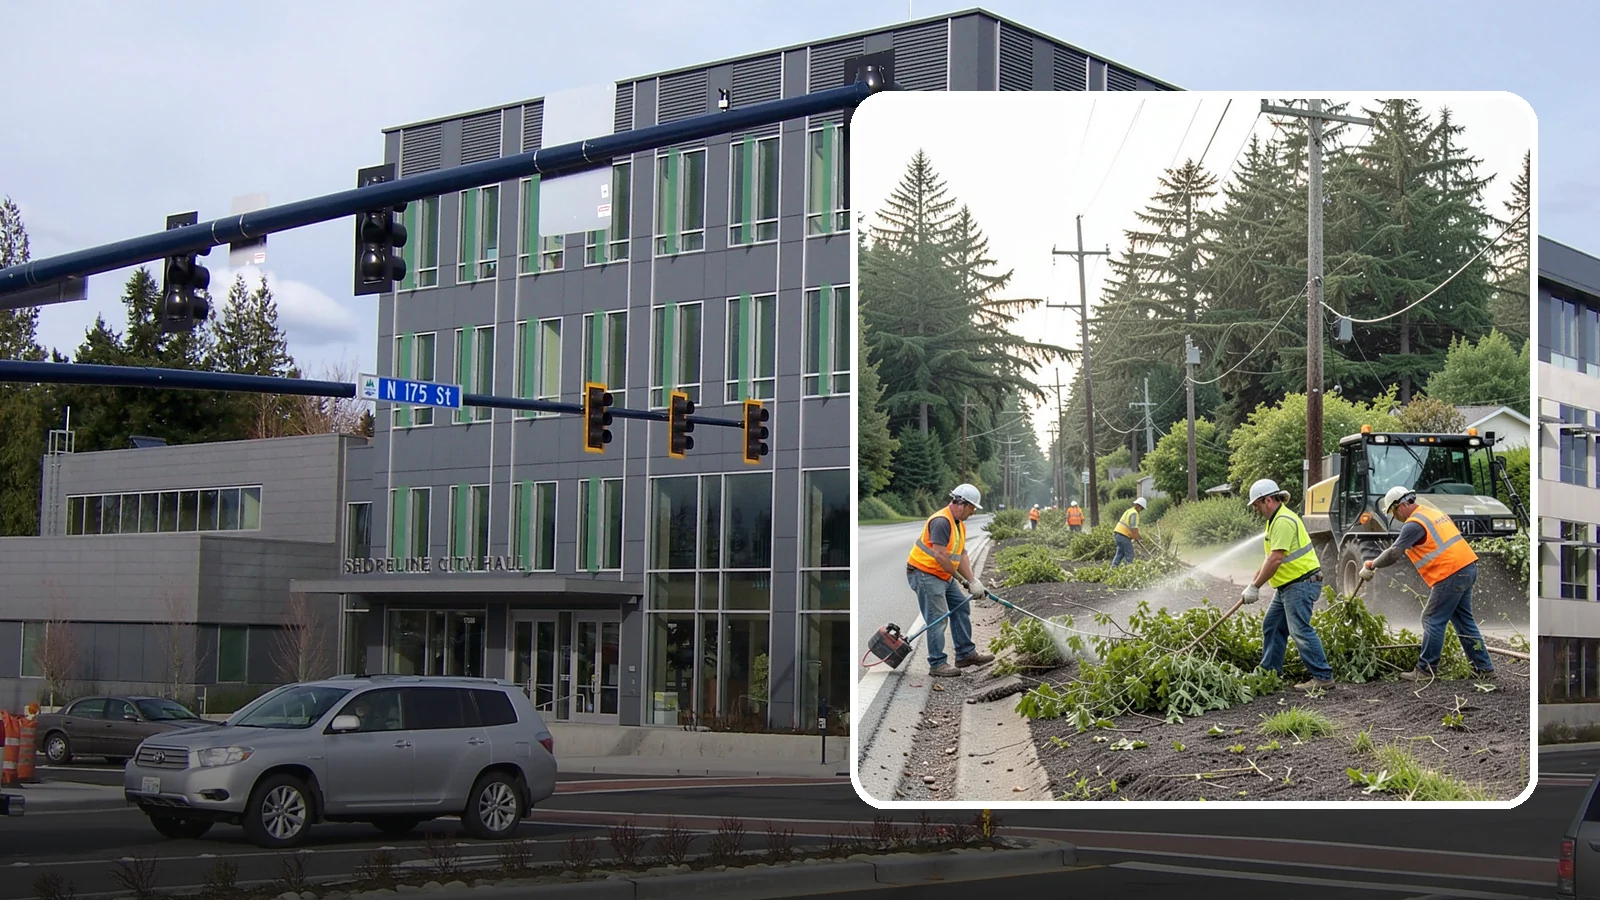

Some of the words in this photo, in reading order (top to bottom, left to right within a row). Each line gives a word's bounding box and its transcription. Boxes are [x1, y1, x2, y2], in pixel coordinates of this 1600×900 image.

[387, 380, 396, 400] N
[405, 383, 427, 403] 175
[436, 386, 451, 406] St
[345, 557, 433, 574] SHORELINE
[438, 557, 476, 573] CITY
[484, 556, 525, 573] HALL
